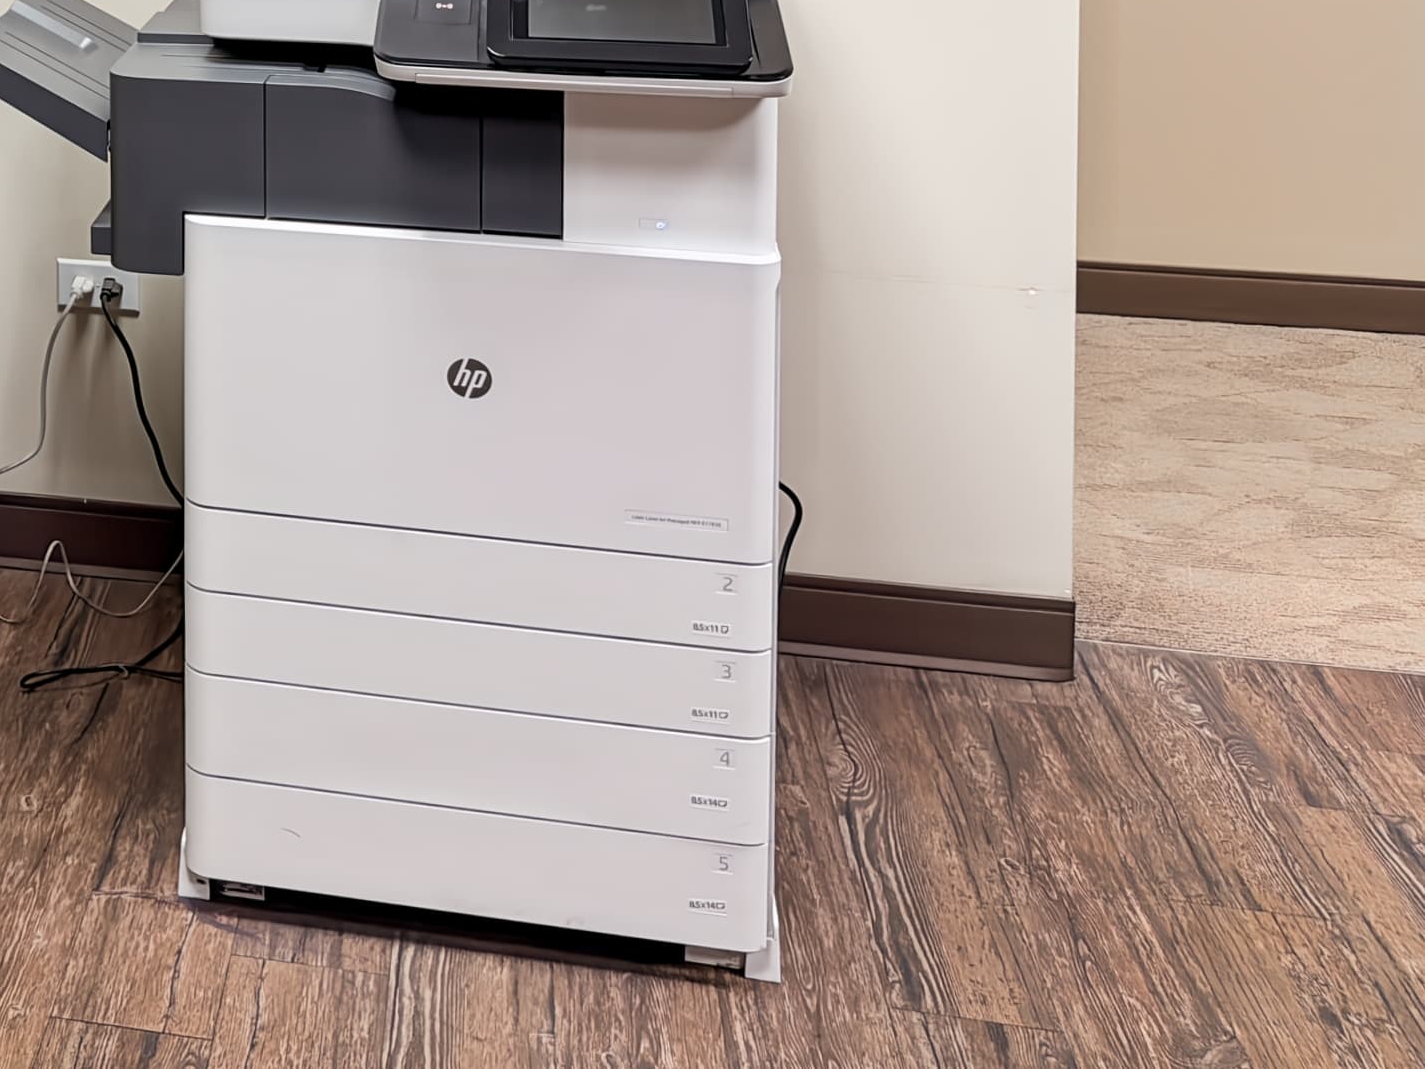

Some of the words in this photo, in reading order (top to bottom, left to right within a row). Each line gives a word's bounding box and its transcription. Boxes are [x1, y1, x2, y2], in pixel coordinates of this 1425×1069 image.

[448, 358, 491, 399] hp
[722, 576, 733, 592] 2
[721, 663, 732, 680] 3
[719, 750, 730, 766] 4
[719, 856, 729, 872] 5
